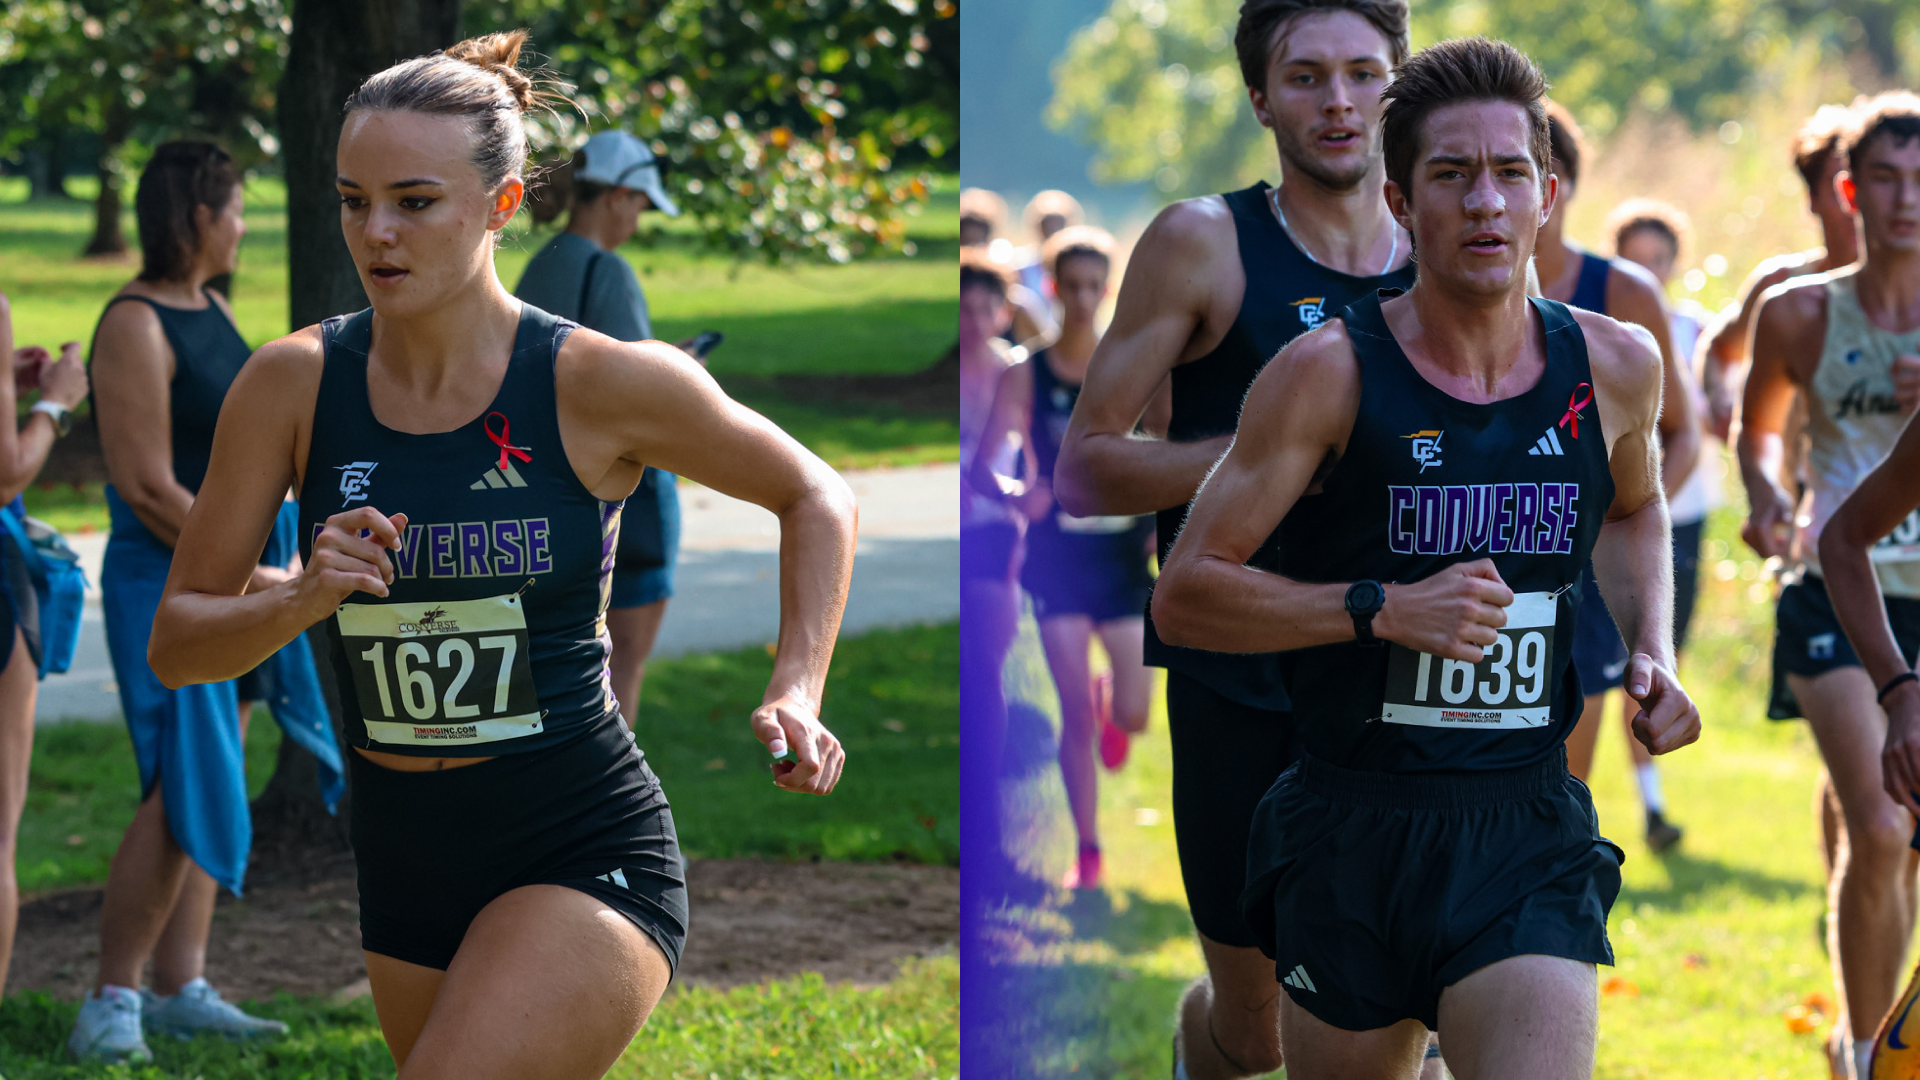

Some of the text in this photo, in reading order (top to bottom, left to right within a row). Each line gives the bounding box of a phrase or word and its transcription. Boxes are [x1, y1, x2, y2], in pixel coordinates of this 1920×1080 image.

[311, 517, 553, 579] VERSE
[1387, 483, 1579, 555] CONVERSE
[398, 620, 458, 634] CONVERSE
[361, 634, 517, 720] 1627
[1414, 631, 1546, 705] 1639
[413, 726, 477, 735] TIMINGINC.COM
[1441, 710, 1502, 719] TIMINGINC.COM
